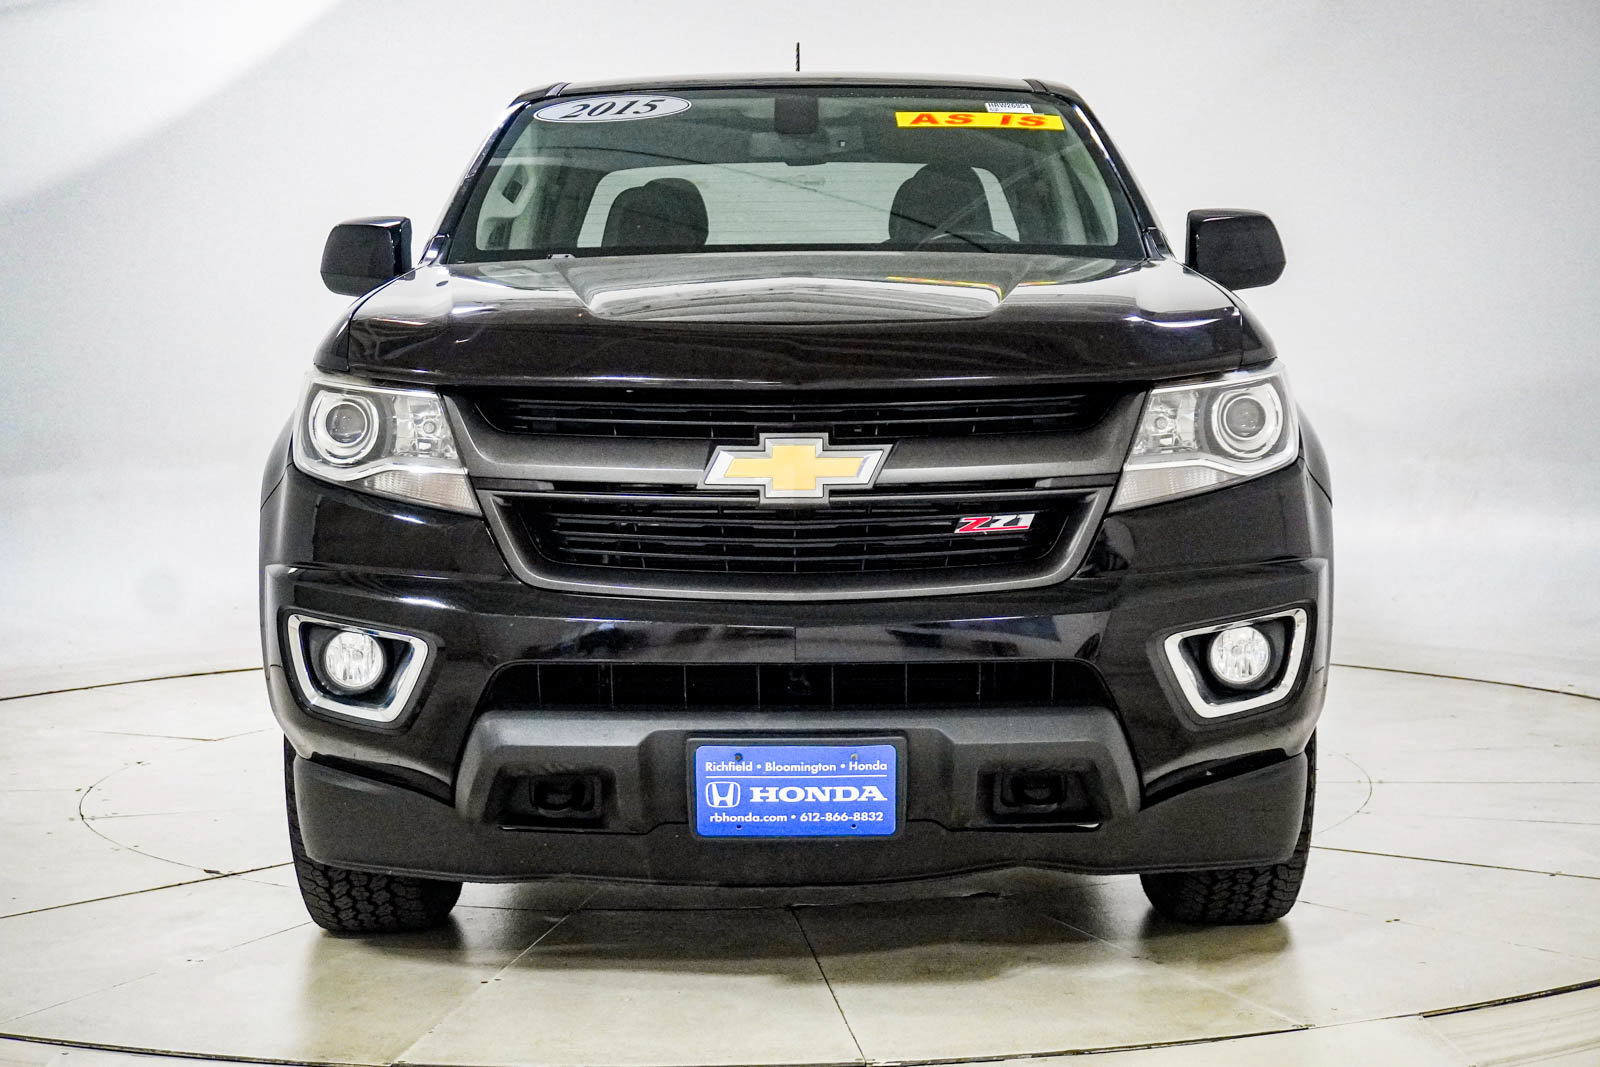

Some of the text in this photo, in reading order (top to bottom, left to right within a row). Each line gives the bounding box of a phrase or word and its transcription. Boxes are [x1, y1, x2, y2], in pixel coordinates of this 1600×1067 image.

[560, 98, 666, 119] 2015
[910, 113, 1048, 127] AS IS
[953, 513, 1036, 534] Z71
[705, 760, 888, 774] Richfield Bloomington Honda
[749, 785, 888, 803] HONDA
[709, 811, 884, 823] rbhonda.com 612-866-8832
